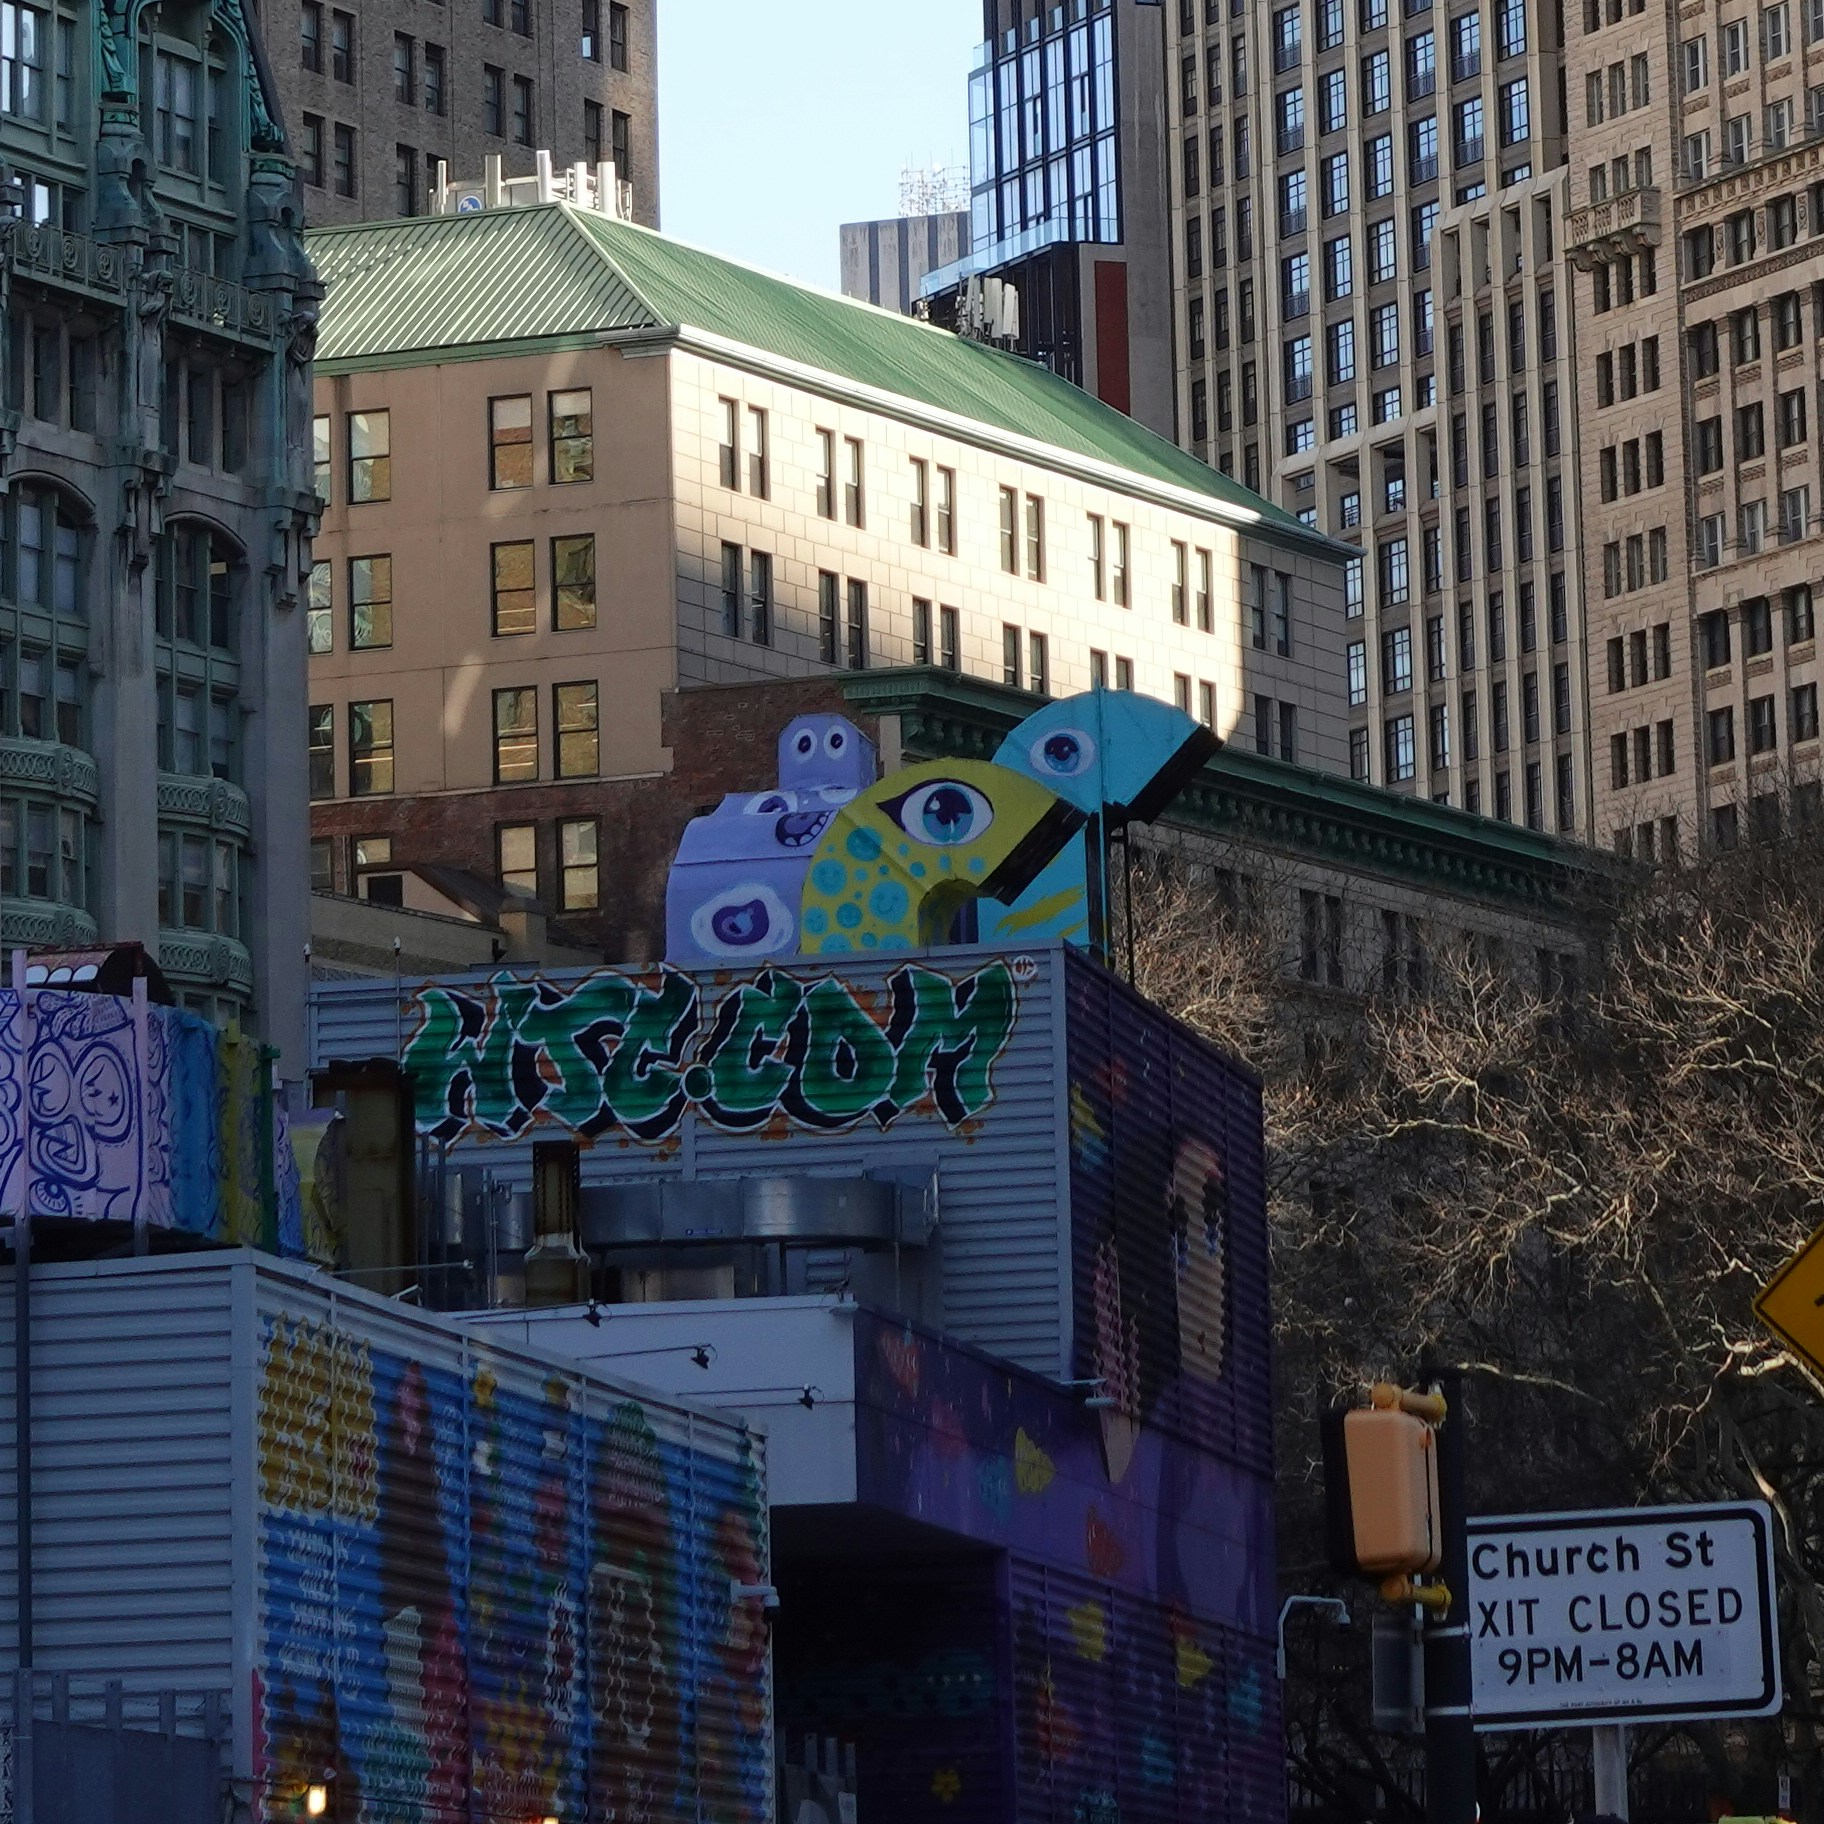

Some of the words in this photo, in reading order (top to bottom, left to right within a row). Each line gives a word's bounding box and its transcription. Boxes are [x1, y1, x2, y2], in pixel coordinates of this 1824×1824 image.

[1472, 1536, 1640, 1580] Church
[1665, 1530, 1714, 1569] St
[1568, 1587, 1743, 1633] CLOSED
[1498, 1638, 1704, 1686] 9PM-8AM
